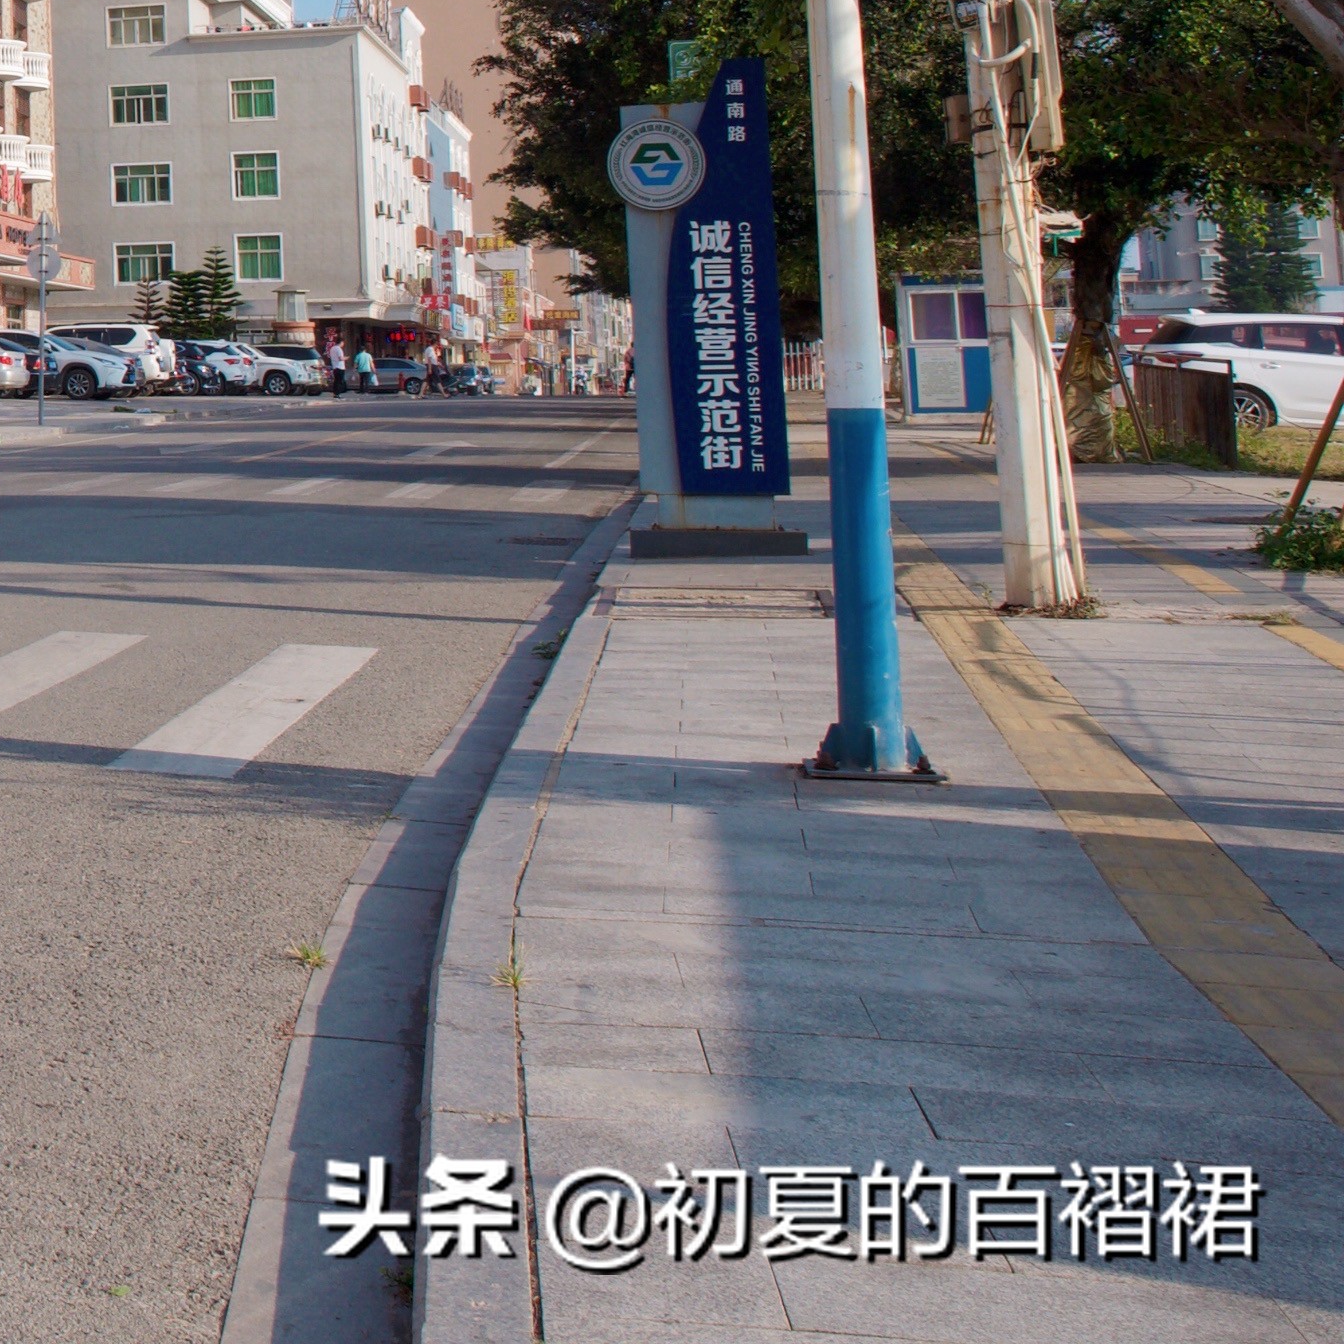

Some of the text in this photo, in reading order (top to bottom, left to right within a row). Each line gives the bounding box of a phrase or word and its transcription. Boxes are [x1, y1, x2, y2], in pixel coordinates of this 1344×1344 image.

[725, 79, 746, 143] 通南路
[738, 221, 754, 275] CHENG
[742, 278, 756, 305] XIN
[743, 306, 758, 343] JING
[689, 220, 744, 470] 诚信经营示范街
[747, 386, 761, 412] SHI
[749, 414, 763, 447] FAN
[751, 447, 765, 473] JIE
